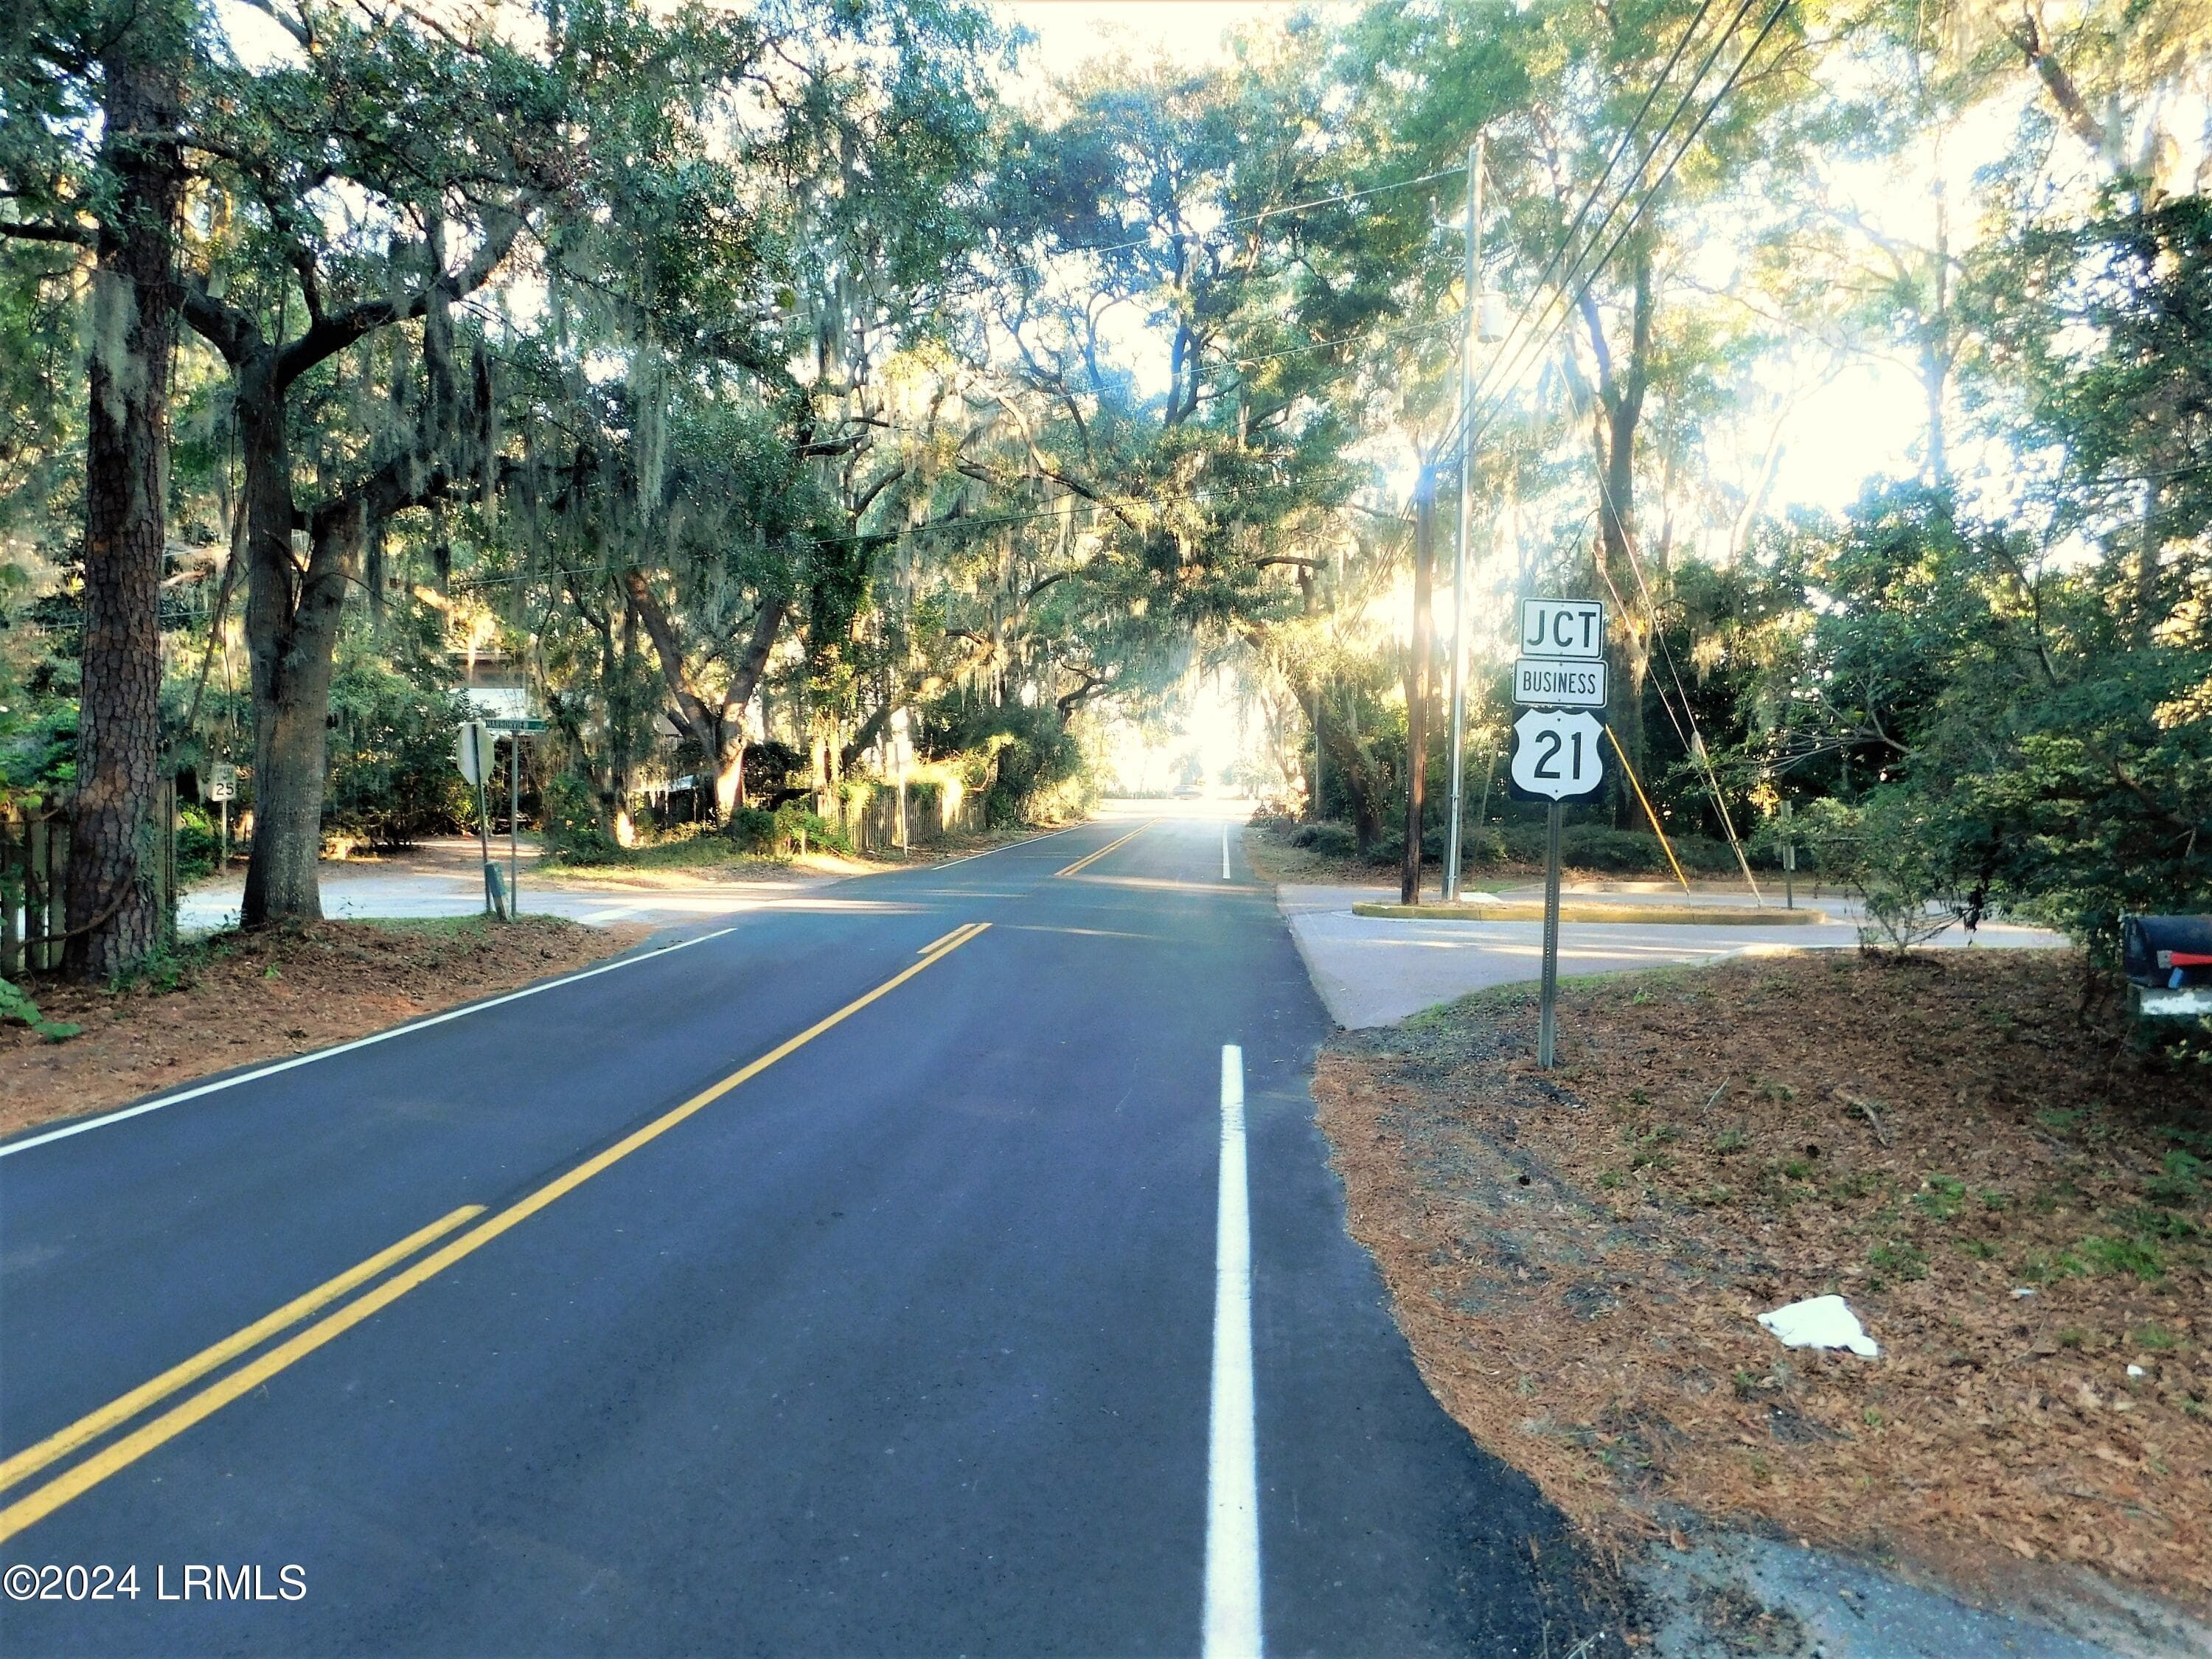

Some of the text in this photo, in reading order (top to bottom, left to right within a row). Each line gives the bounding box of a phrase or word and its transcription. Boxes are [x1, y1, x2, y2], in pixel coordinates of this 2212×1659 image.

[1526, 609, 1596, 648] JCT
[1523, 671, 1596, 695] BUSINESS
[1534, 730, 1582, 780] 21
[216, 782, 234, 796] 25
